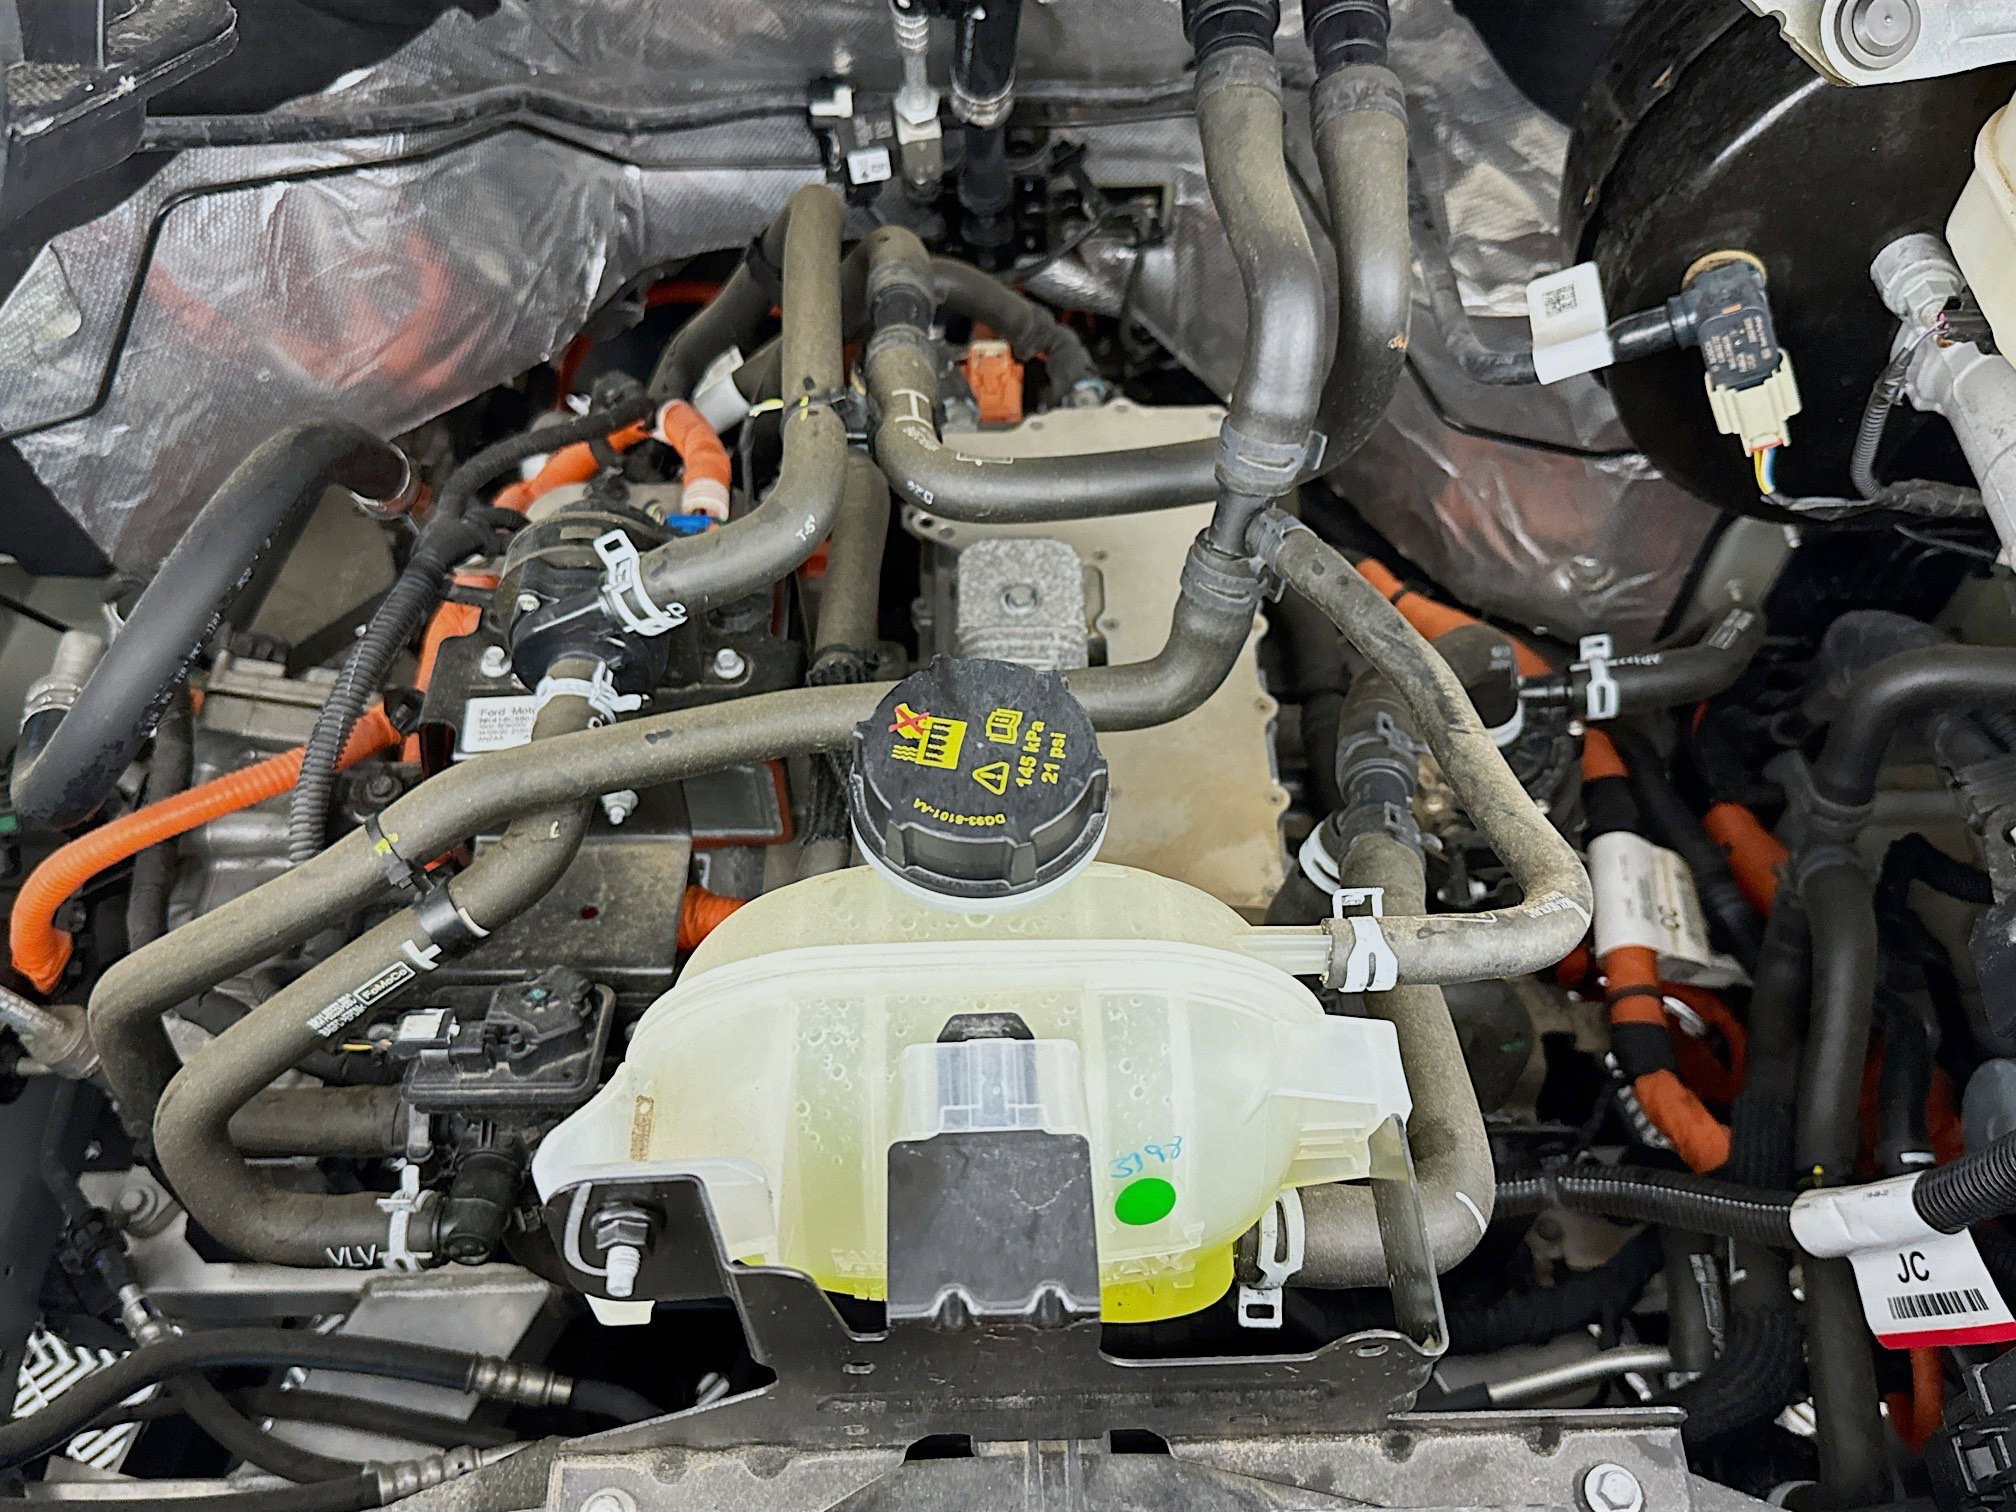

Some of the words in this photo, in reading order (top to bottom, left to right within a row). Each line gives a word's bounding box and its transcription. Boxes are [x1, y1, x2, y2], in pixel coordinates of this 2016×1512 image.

[481, 707, 506, 717] Ford
[1022, 720, 1046, 754] kPa
[1049, 731, 1067, 759] psi
[1015, 754, 1038, 788] 145
[1040, 762, 1061, 785] 21
[912, 797, 1006, 827] DG93-8101-AA
[361, 967, 408, 1000] FoMoCo
[325, 1243, 377, 1267] VLV
[1897, 1250, 1930, 1284] JC
